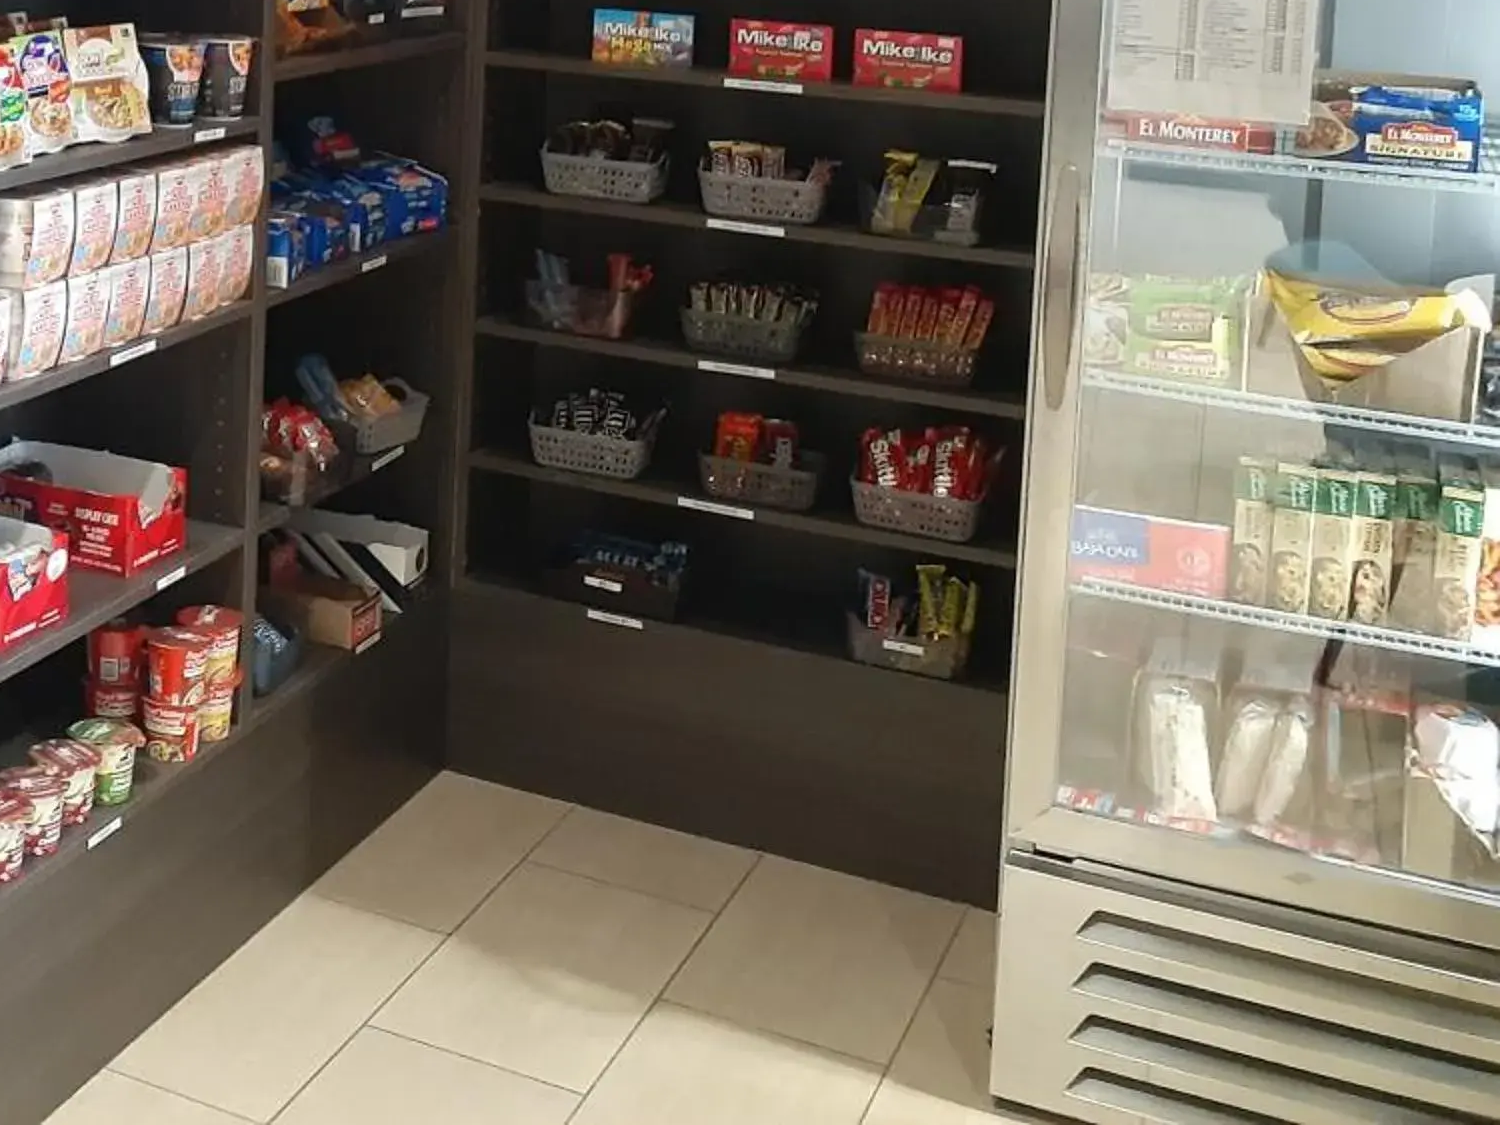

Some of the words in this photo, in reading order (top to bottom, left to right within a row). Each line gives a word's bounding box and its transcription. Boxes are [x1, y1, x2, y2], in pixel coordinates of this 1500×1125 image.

[605, 22, 650, 39] Mike
[737, 28, 788, 48] Mike
[792, 31, 823, 52] Ike
[863, 38, 915, 59] Mike
[920, 45, 954, 65] Ike
[1159, 120, 1241, 144] MONTEREY
